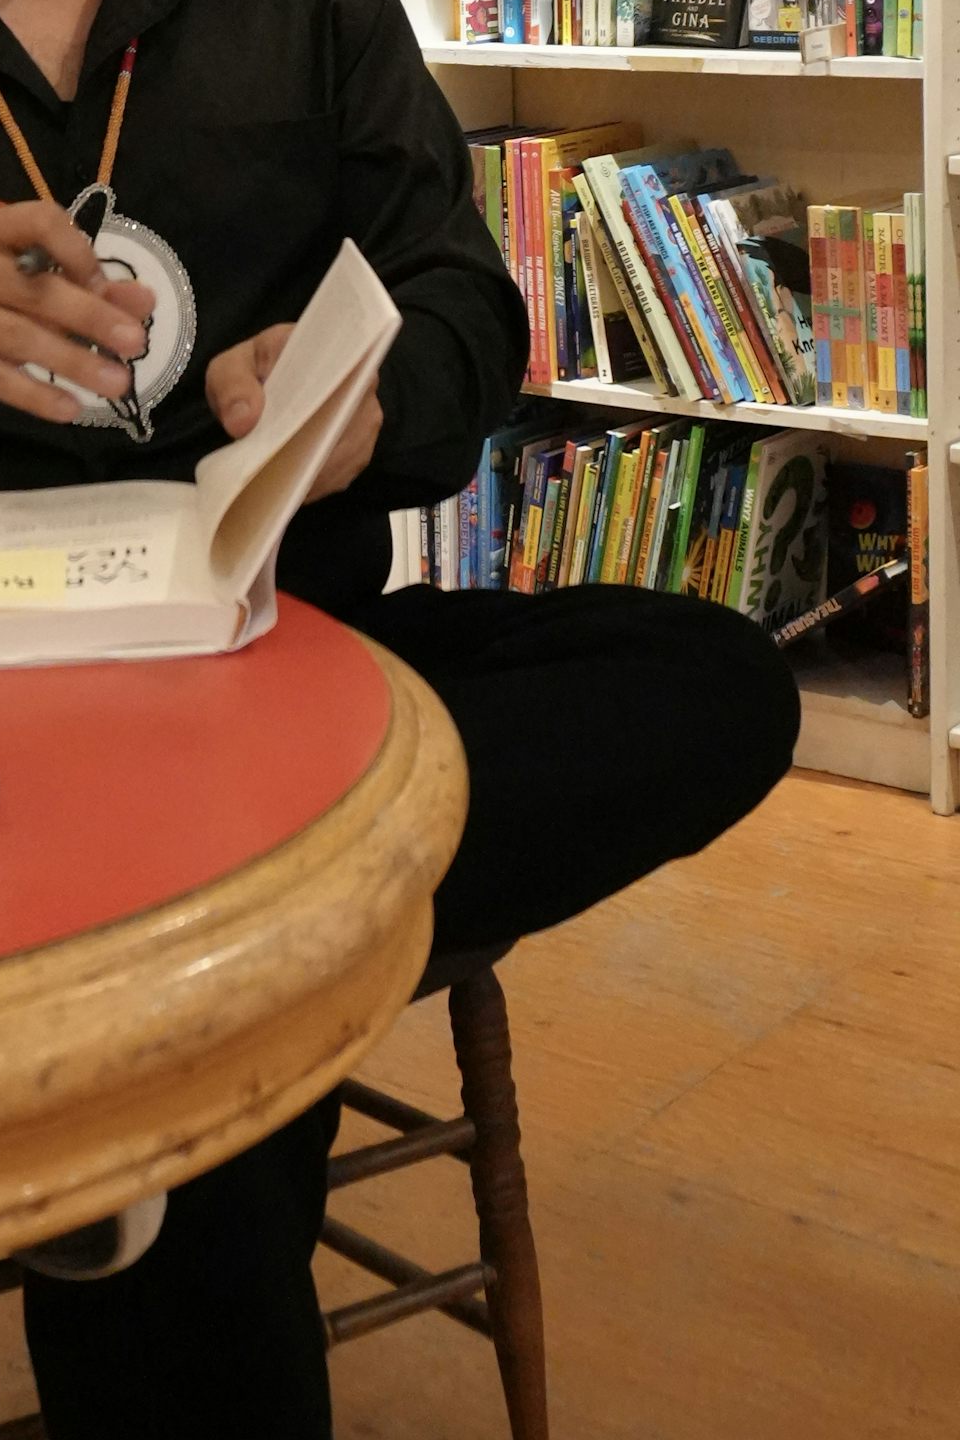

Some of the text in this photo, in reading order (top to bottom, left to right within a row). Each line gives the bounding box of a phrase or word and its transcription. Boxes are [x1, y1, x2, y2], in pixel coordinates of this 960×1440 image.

[671, 11, 711, 30] GINA
[639, 203, 670, 260] FISH FRIENDS
[691, 227, 709, 252] GREAT
[704, 232, 721, 254] DIRT!
[525, 268, 533, 294] AMAZING
[535, 268, 545, 331] AMAZING CHEMISTRY
[552, 274, 567, 306] SPACE?
[578, 238, 600, 320] BRAIDING SWEETGRASS
[614, 240, 653, 315] NATURAL WORLD
[694, 255, 738, 338] THE GLAND FACTORY
[829, 272, 841, 330] ANATOMY
[867, 276, 880, 332] ANATOMY
[876, 227, 891, 343] NATURE ANATOMY
[526, 295, 534, 331] CHEMISTRY
[894, 279, 908, 341] ANATOMY
[640, 497, 658, 556] THINGS SCIENTISTS
[732, 487, 755, 572] WHY? ANIMALS
[858, 533, 898, 551] WHY
[778, 594, 842, 644] TREASURES
